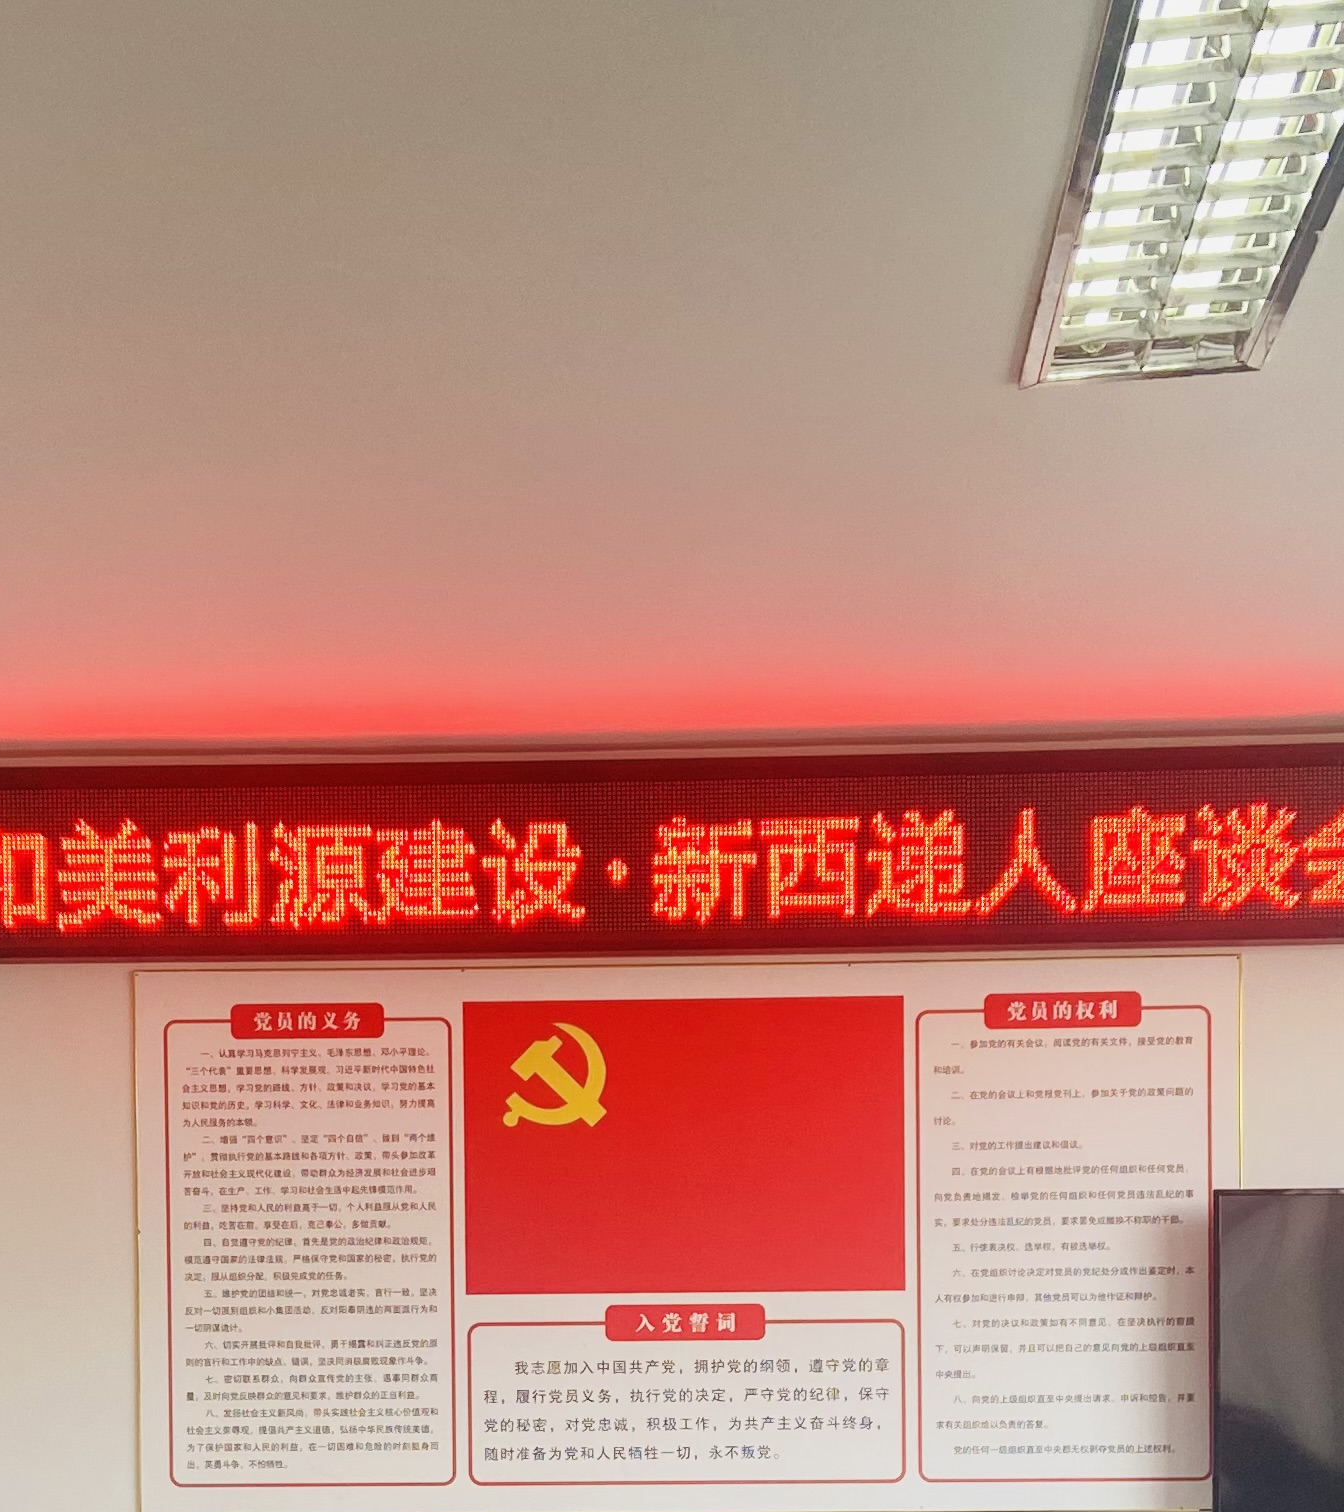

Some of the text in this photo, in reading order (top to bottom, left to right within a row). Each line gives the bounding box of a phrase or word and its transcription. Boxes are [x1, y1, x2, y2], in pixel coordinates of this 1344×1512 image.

[1008, 1000, 1119, 1021] 党员的权利
[254, 1012, 361, 1031] 党员的义务
[635, 1312, 737, 1333] 入党誓词
[515, 1358, 890, 1375] 我志愿加入中国共产党，拥护党的纲领，遵守党的章
[484, 1387, 890, 1404] 程，履行党员义务，执行党的决定，严守党的纪律，保守
[484, 1416, 882, 1433] 党的秘密，对党忠诚，积极工作，为共产主义奋斗终身，
[484, 1445, 781, 1461] 随时准备为党和人民牺牲一切，永不叛党。
